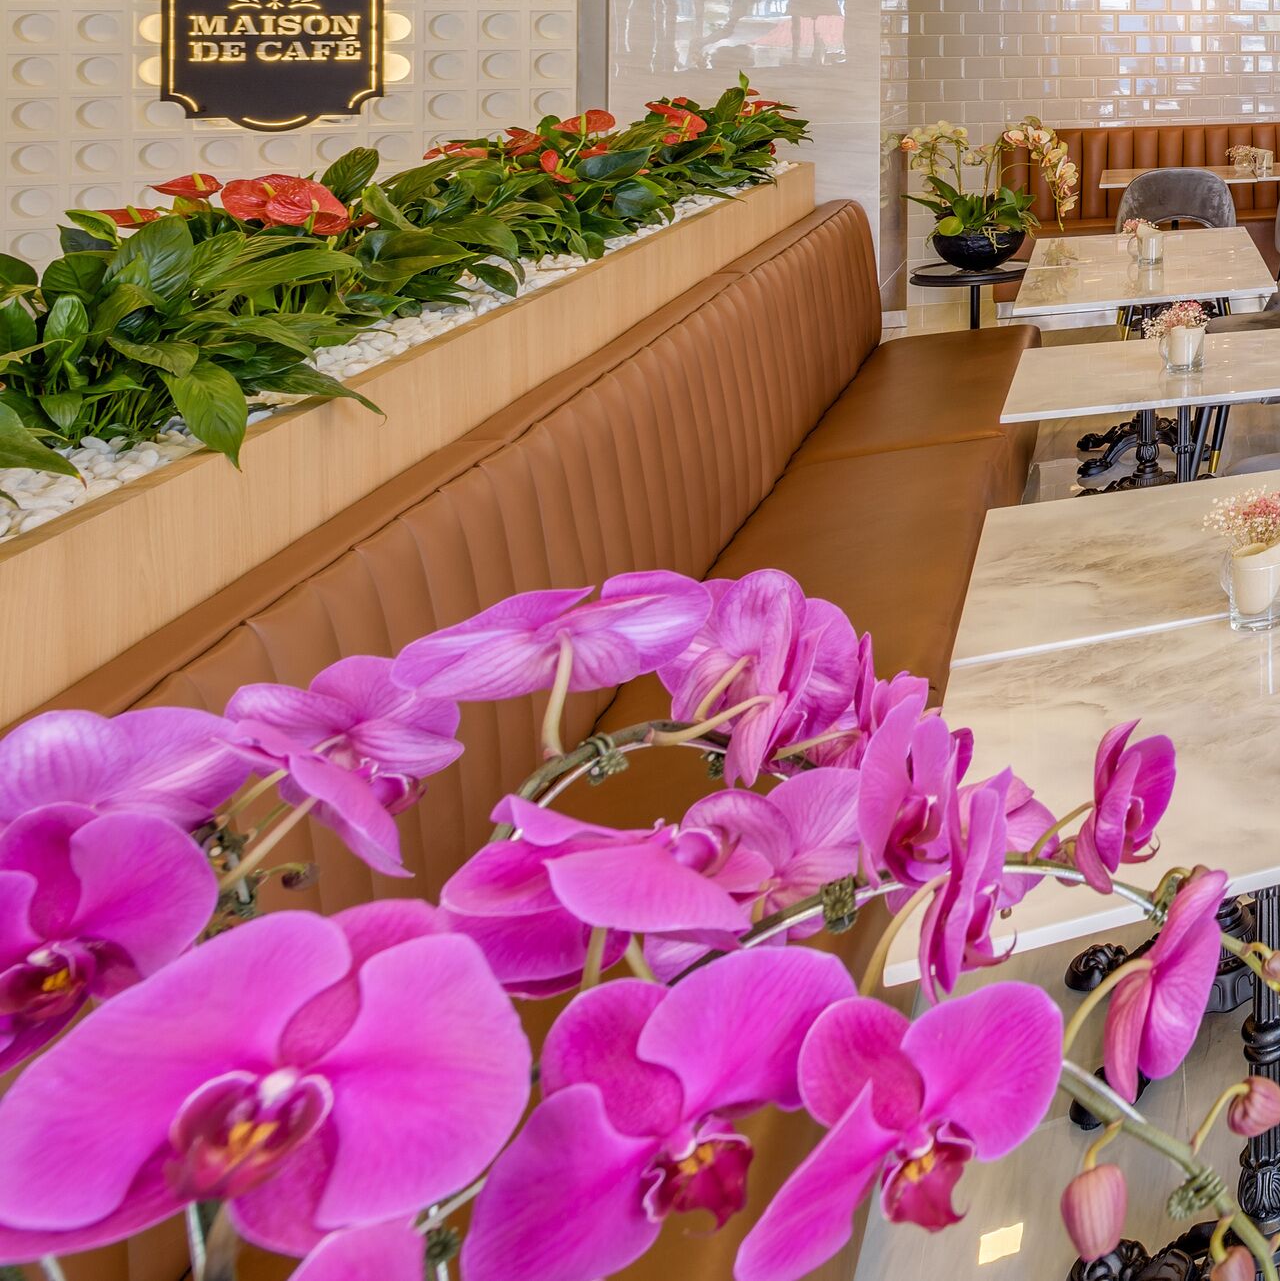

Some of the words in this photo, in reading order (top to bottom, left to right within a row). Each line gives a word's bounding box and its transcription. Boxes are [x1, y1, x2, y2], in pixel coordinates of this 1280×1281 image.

[188, 15, 361, 36] MAISON
[188, 41, 246, 62] DE
[256, 36, 361, 61] CAFÉ
